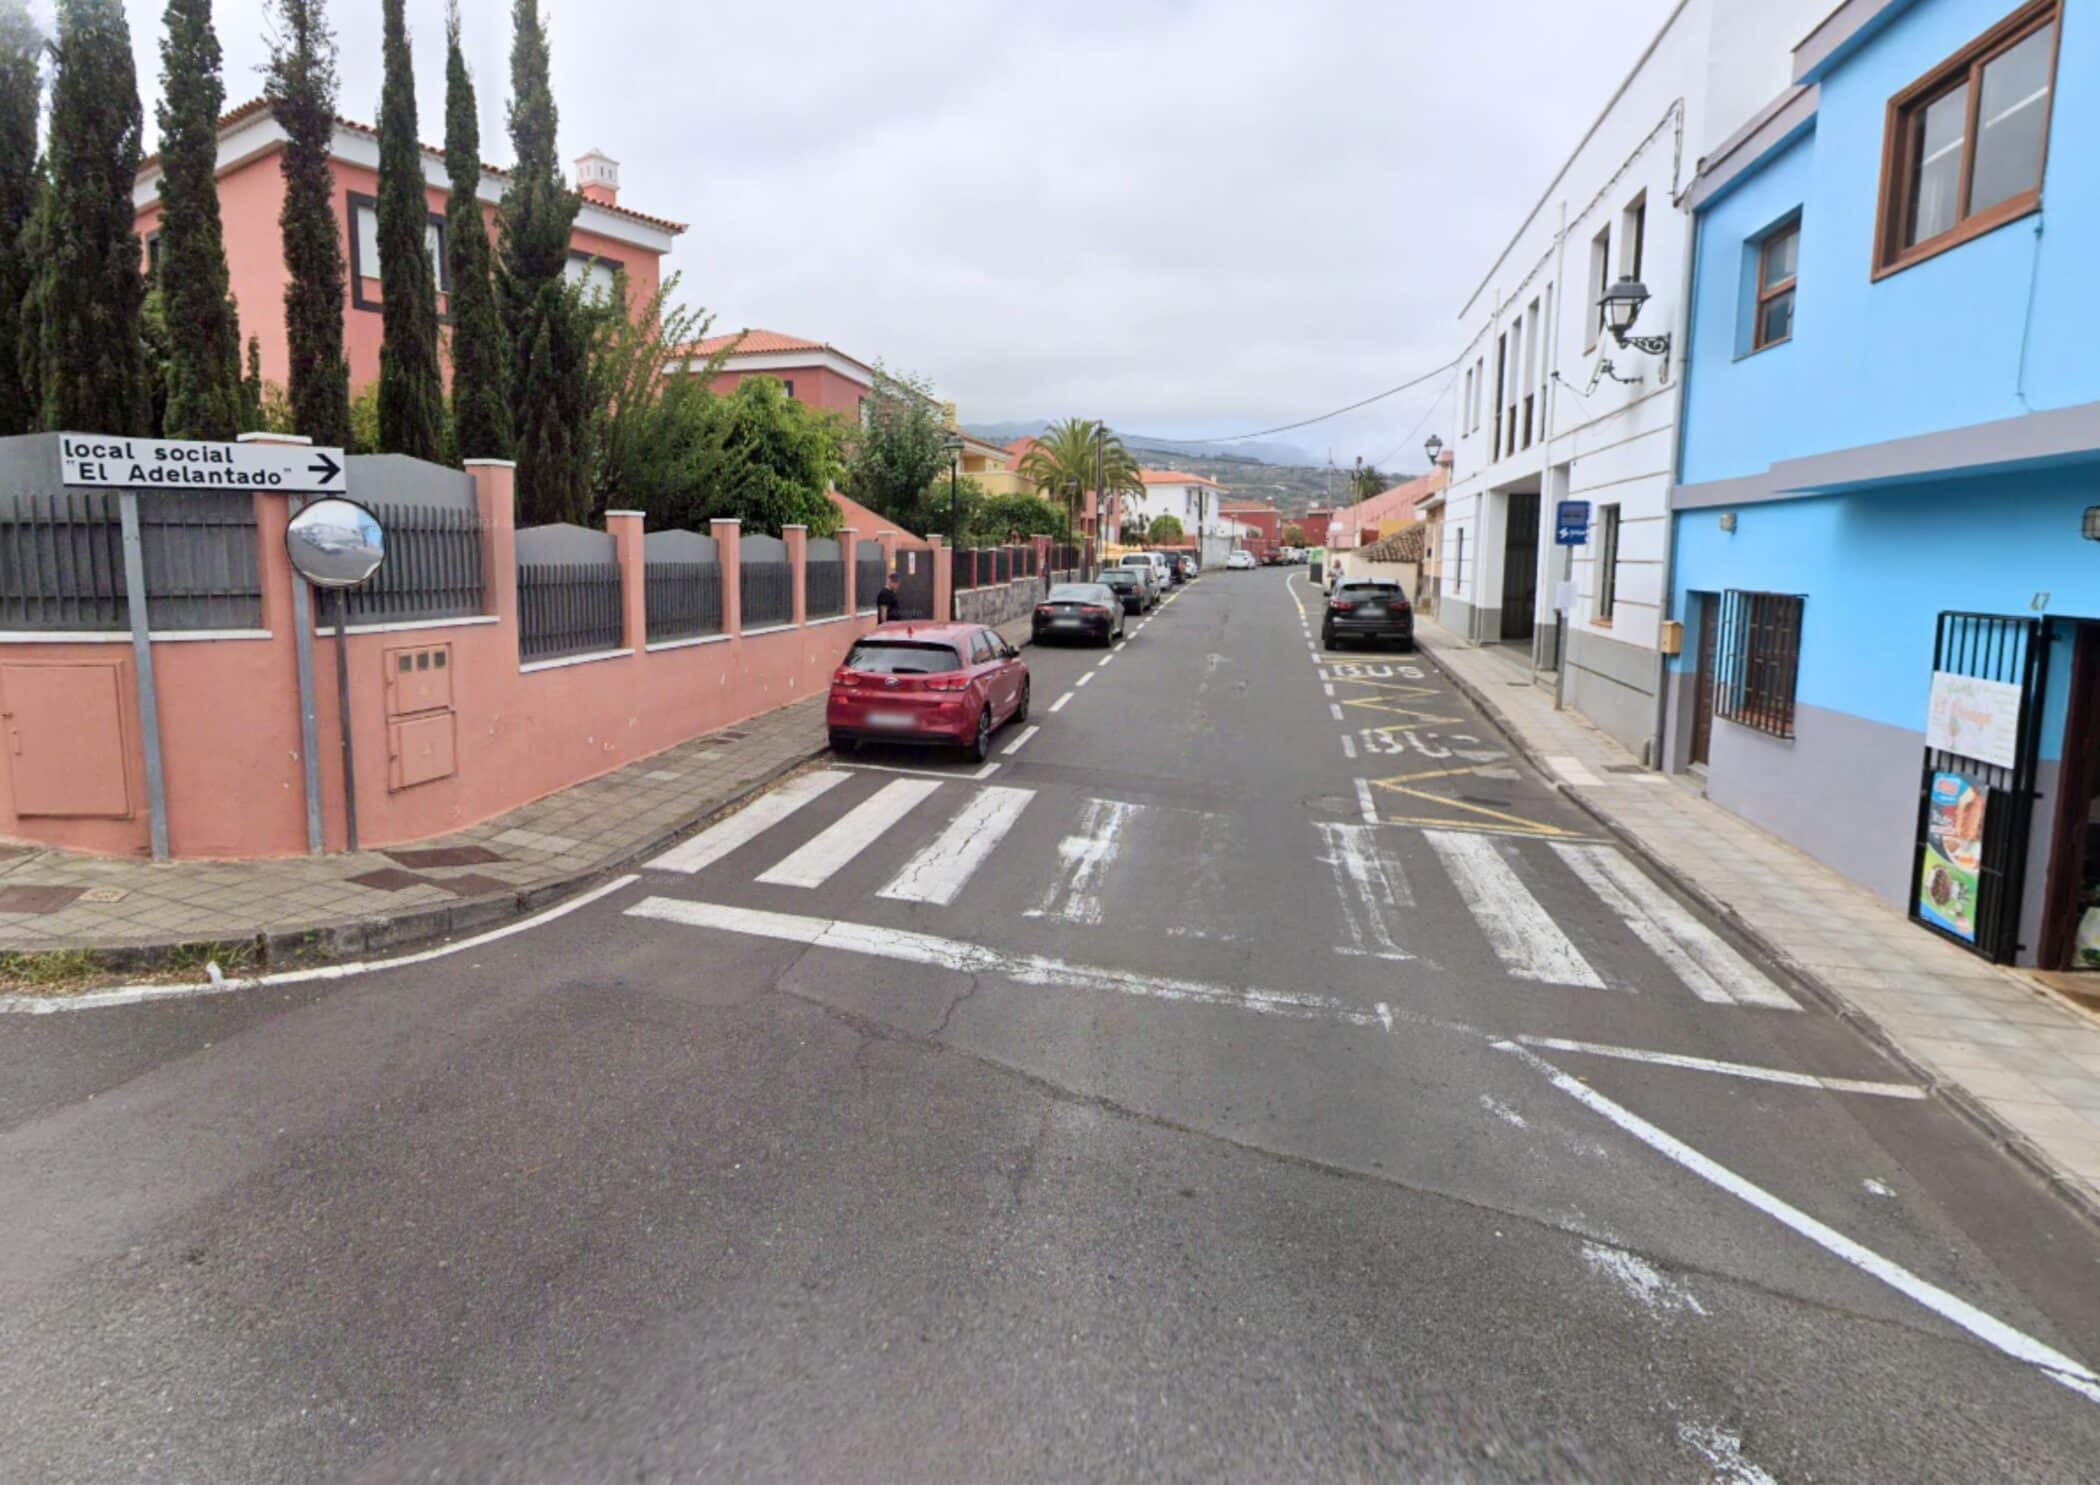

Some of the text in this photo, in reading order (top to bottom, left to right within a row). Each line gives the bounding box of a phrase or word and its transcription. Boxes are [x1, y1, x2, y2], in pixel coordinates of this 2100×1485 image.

[64, 439, 234, 464] local social
[1332, 664, 1425, 679] BUS
